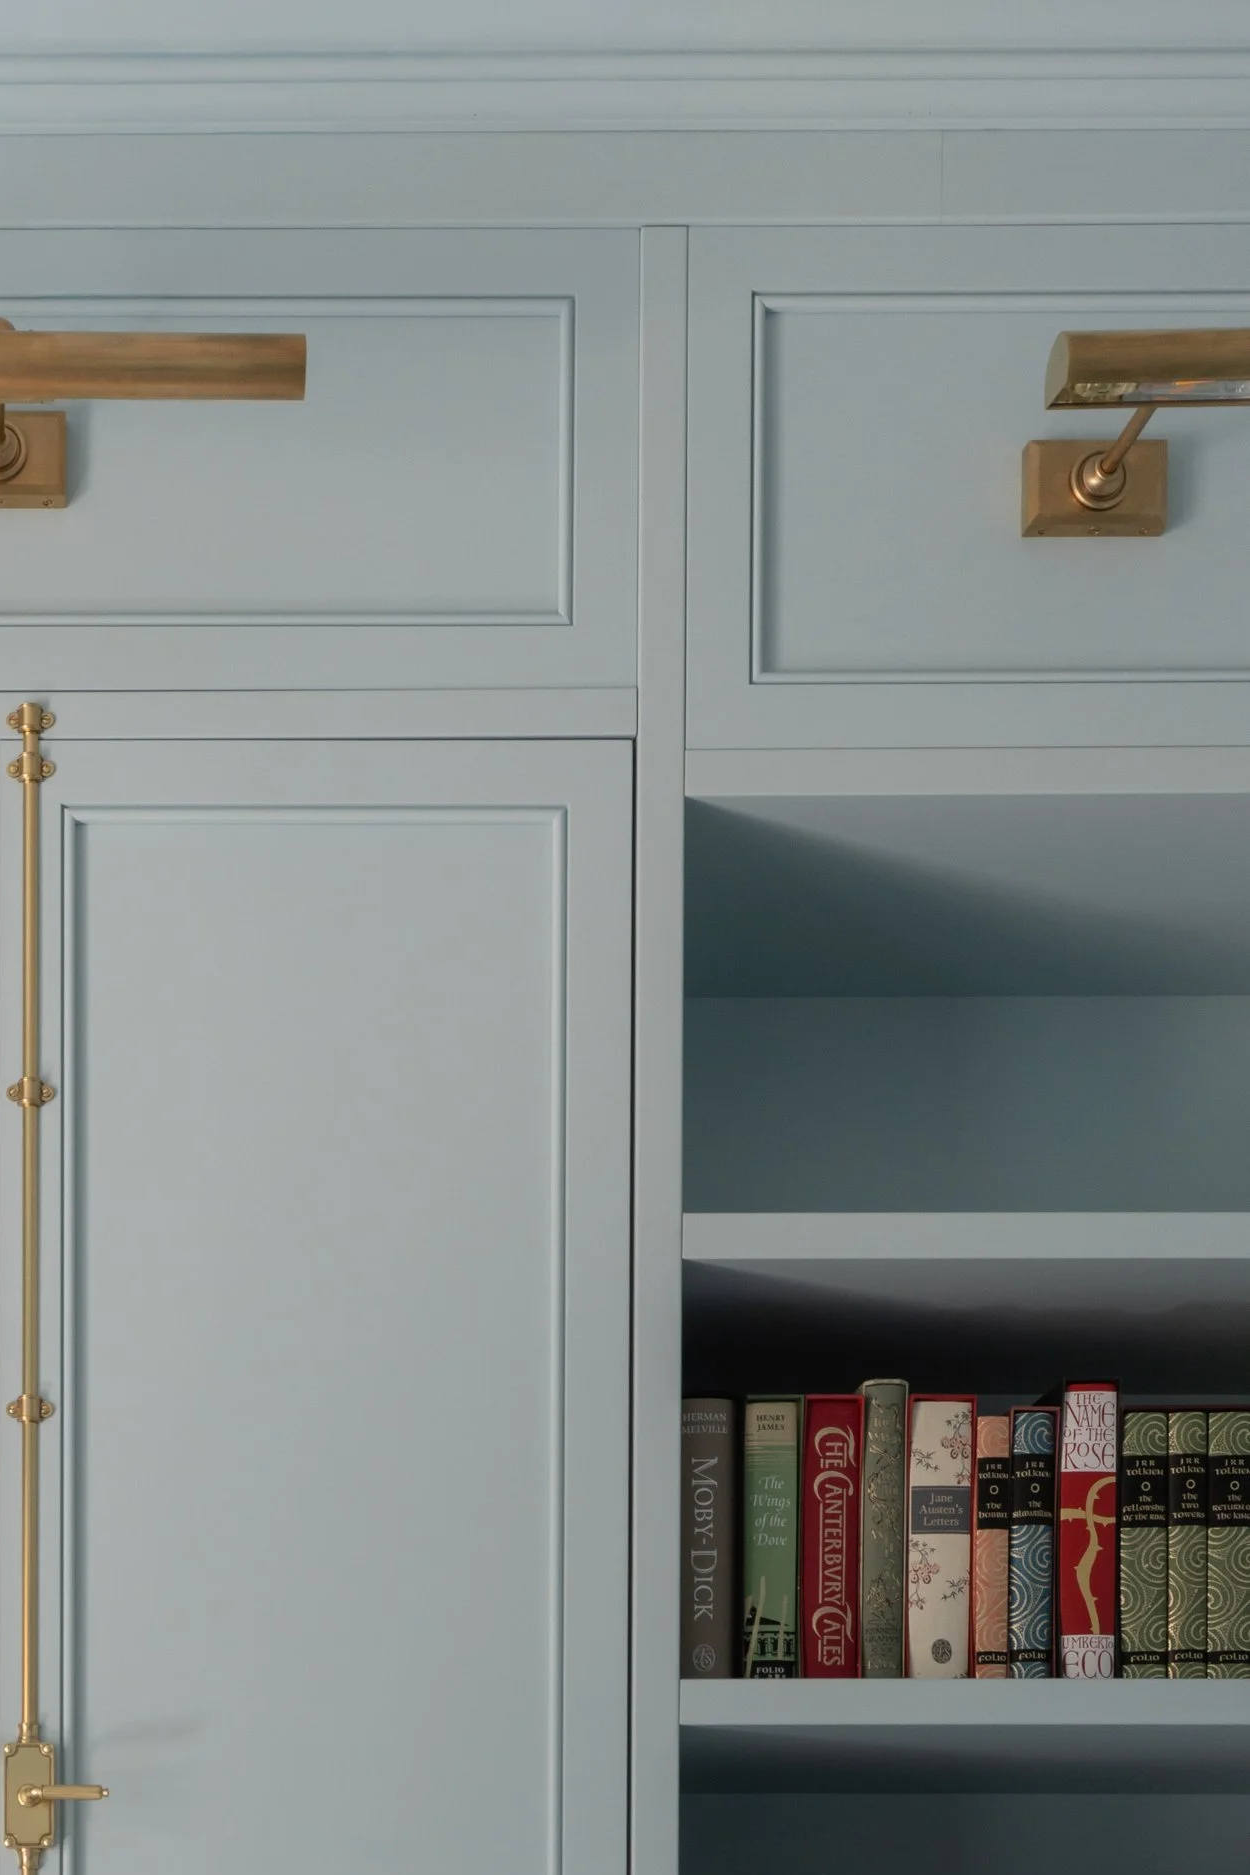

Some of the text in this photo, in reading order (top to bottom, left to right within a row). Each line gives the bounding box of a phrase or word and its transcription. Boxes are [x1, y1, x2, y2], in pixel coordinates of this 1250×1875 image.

[1074, 1393, 1103, 1405] THE
[682, 1412, 727, 1421] HERMAN
[756, 1414, 786, 1422] HENRY
[1065, 1401, 1115, 1428] NAME
[681, 1425, 728, 1434] MELVILLE
[757, 1423, 785, 1432] JAMES
[1063, 1427, 1115, 1440] OF THE
[1063, 1442, 1115, 1470] ROSE
[758, 1475, 784, 1490] The
[750, 1494, 791, 1509] Wings
[929, 1493, 953, 1505] Jane
[918, 1504, 963, 1515] Austen's
[755, 1512, 787, 1532] of the
[923, 1516, 960, 1527] Letters
[691, 1456, 718, 1621] MOBY-DICK
[753, 1533, 788, 1547] Dove
[811, 1602, 854, 1667] TALES
[1061, 1636, 1114, 1650] UMBERTO
[1062, 1650, 1113, 1679] ECO
